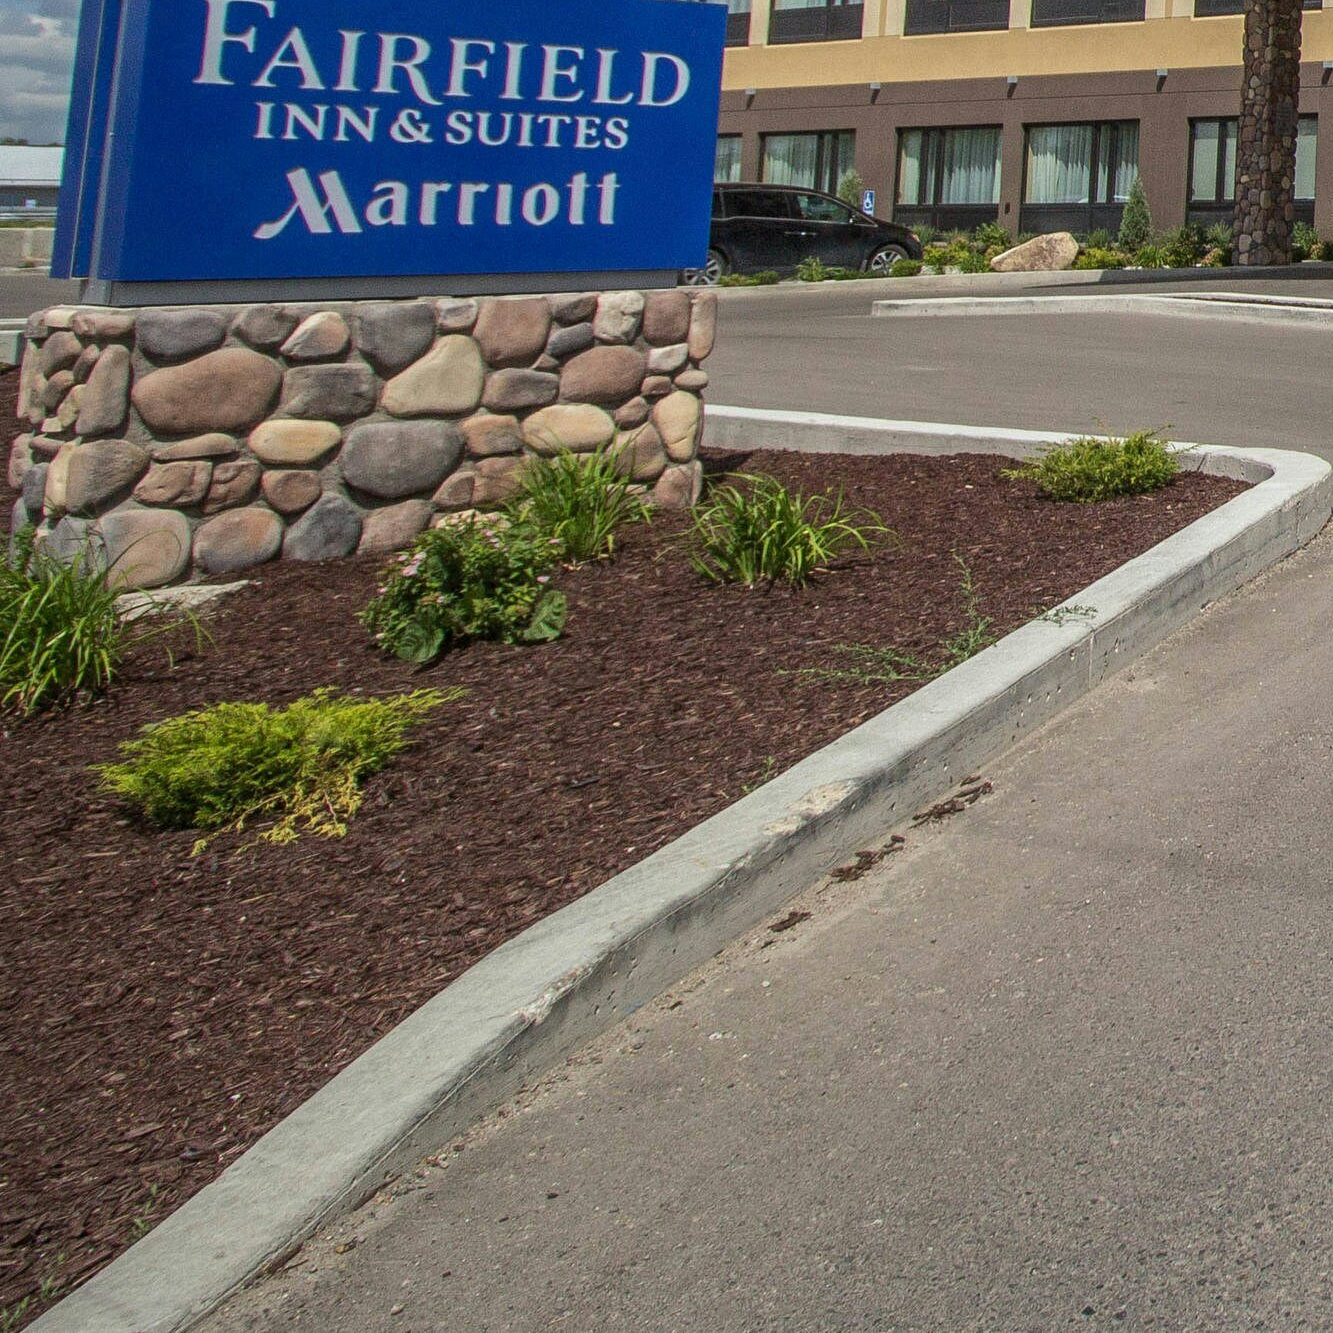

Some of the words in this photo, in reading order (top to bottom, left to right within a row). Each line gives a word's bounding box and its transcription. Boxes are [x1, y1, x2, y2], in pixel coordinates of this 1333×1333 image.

[253, 102, 379, 143] INN
[389, 109, 433, 143] &
[445, 110, 629, 150] SUITES
[253, 168, 621, 240] Marriott
